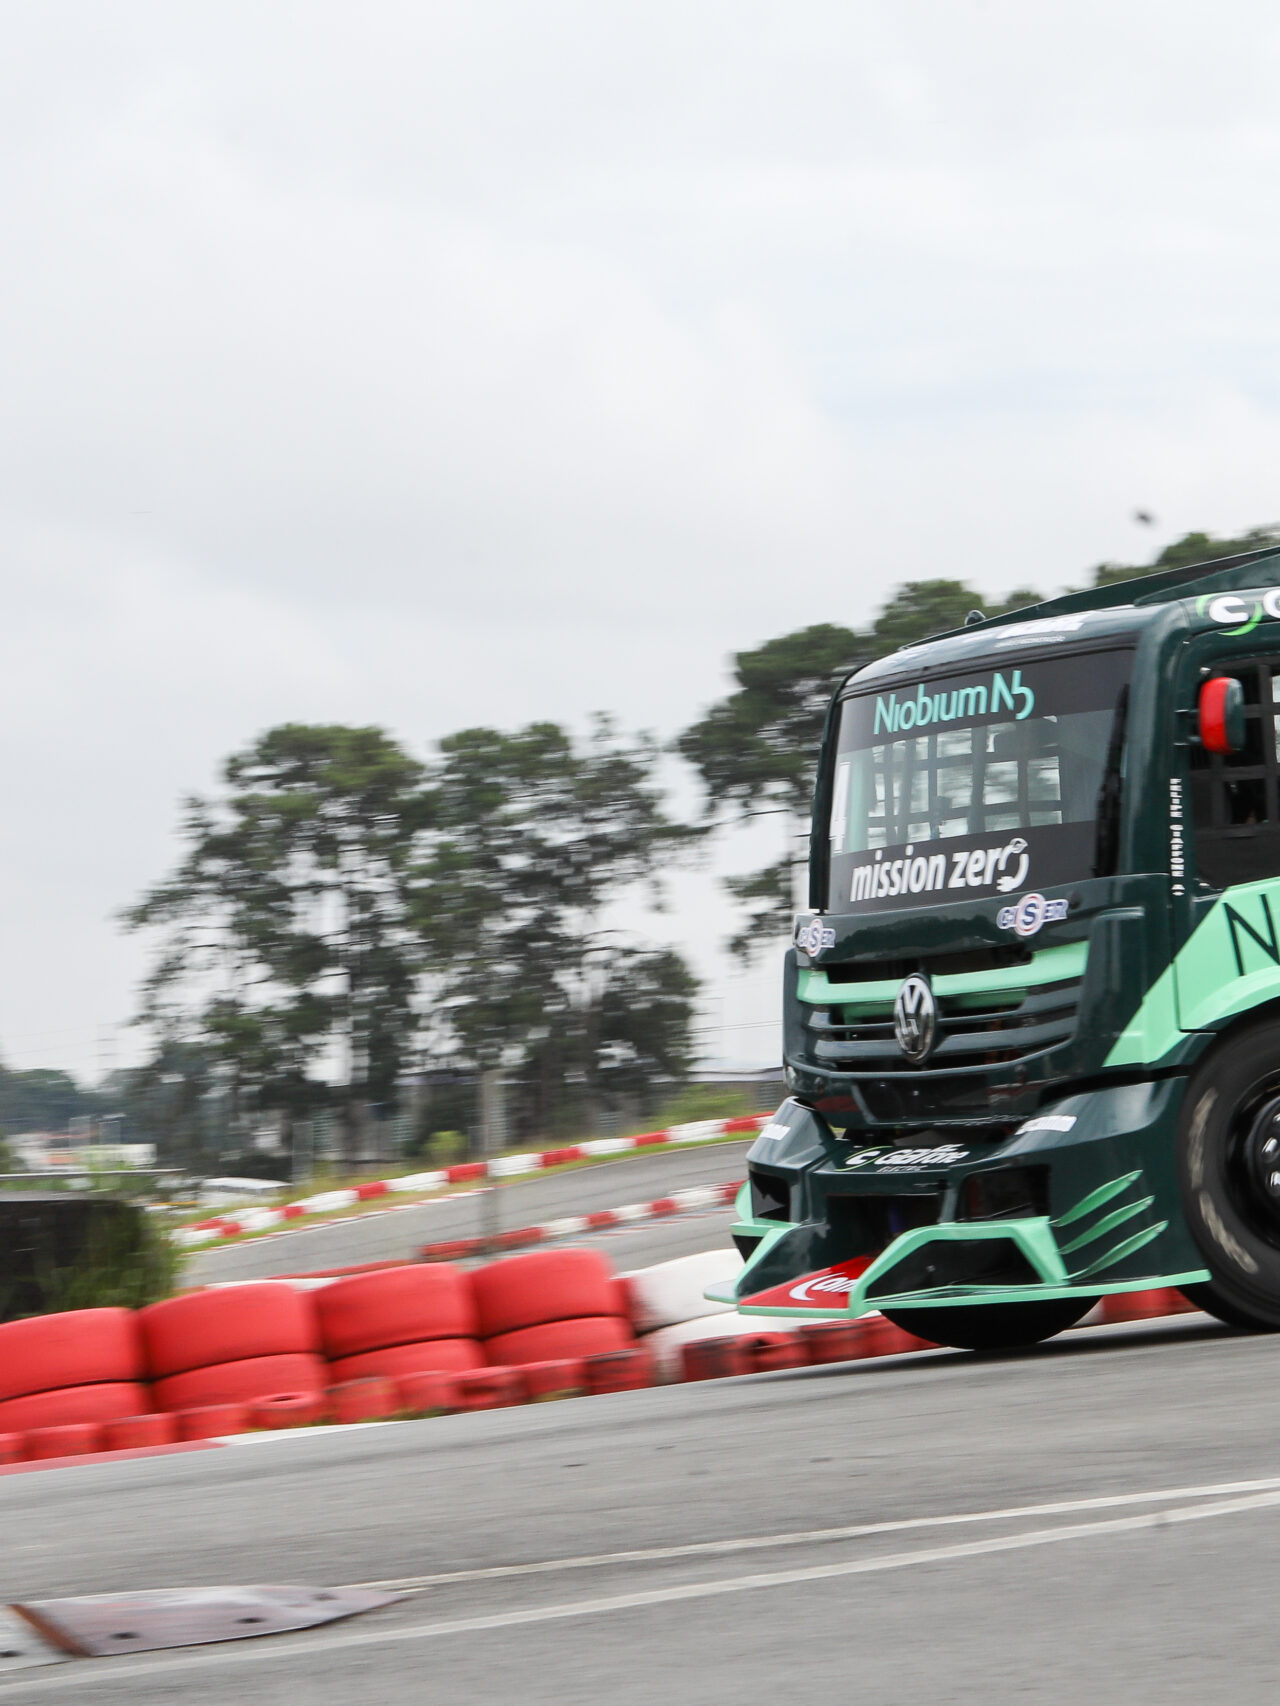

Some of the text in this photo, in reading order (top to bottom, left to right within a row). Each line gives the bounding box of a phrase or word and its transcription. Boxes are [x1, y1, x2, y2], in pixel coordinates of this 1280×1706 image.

[873, 683, 988, 735] Niobium
[850, 837, 1030, 902] mission zero
[996, 892, 1069, 937] CISER
